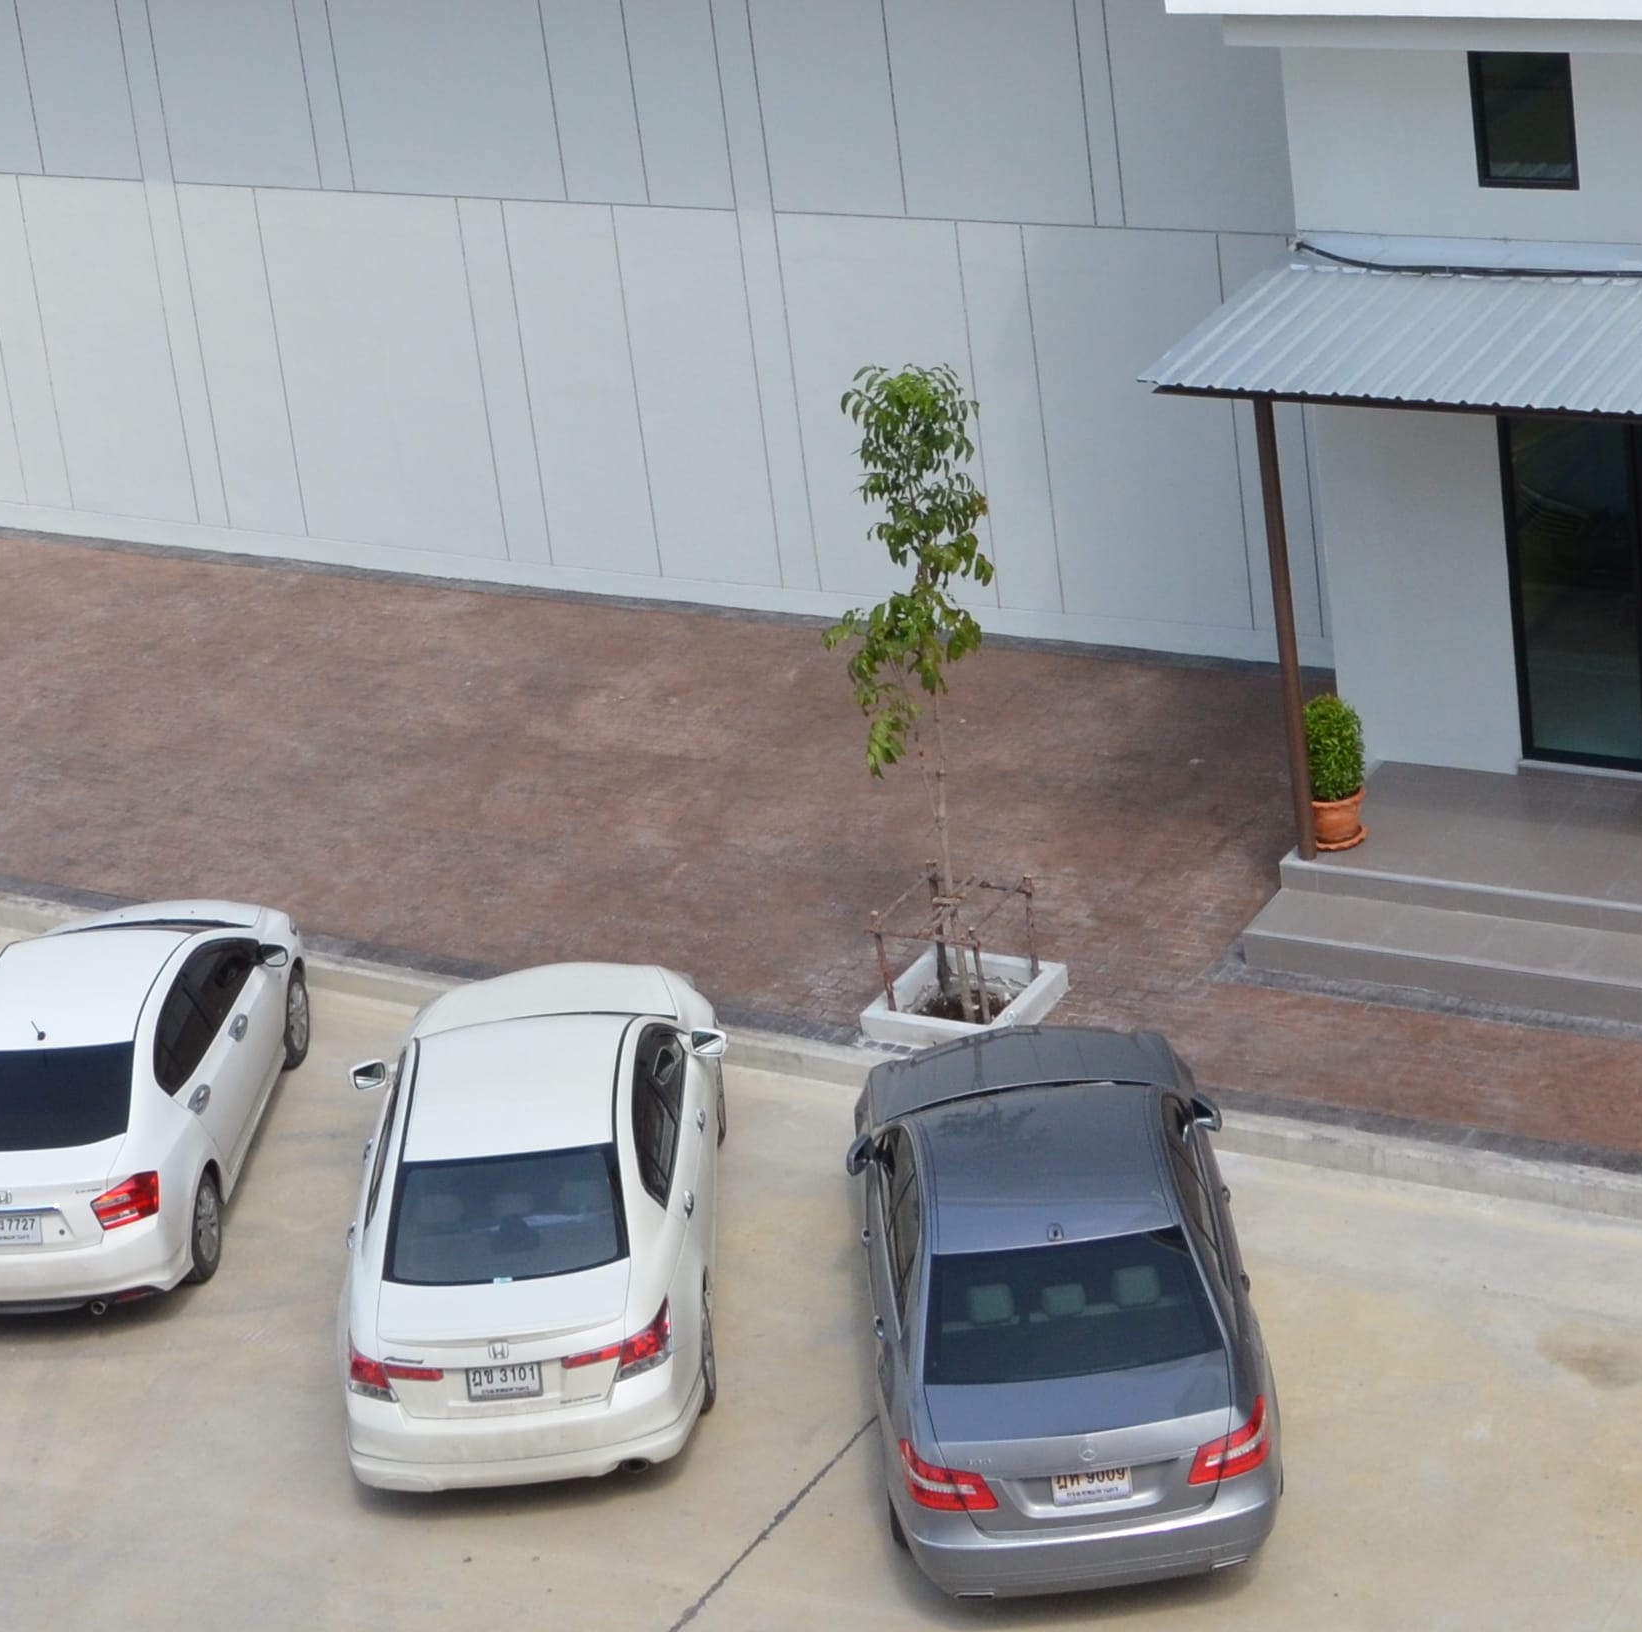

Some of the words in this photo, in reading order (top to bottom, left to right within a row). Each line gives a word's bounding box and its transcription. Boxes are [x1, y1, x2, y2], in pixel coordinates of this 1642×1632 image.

[7, 1218, 36, 1232] 7727
[499, 1365, 536, 1383] 3101
[1085, 1467, 1126, 1484] 9009
